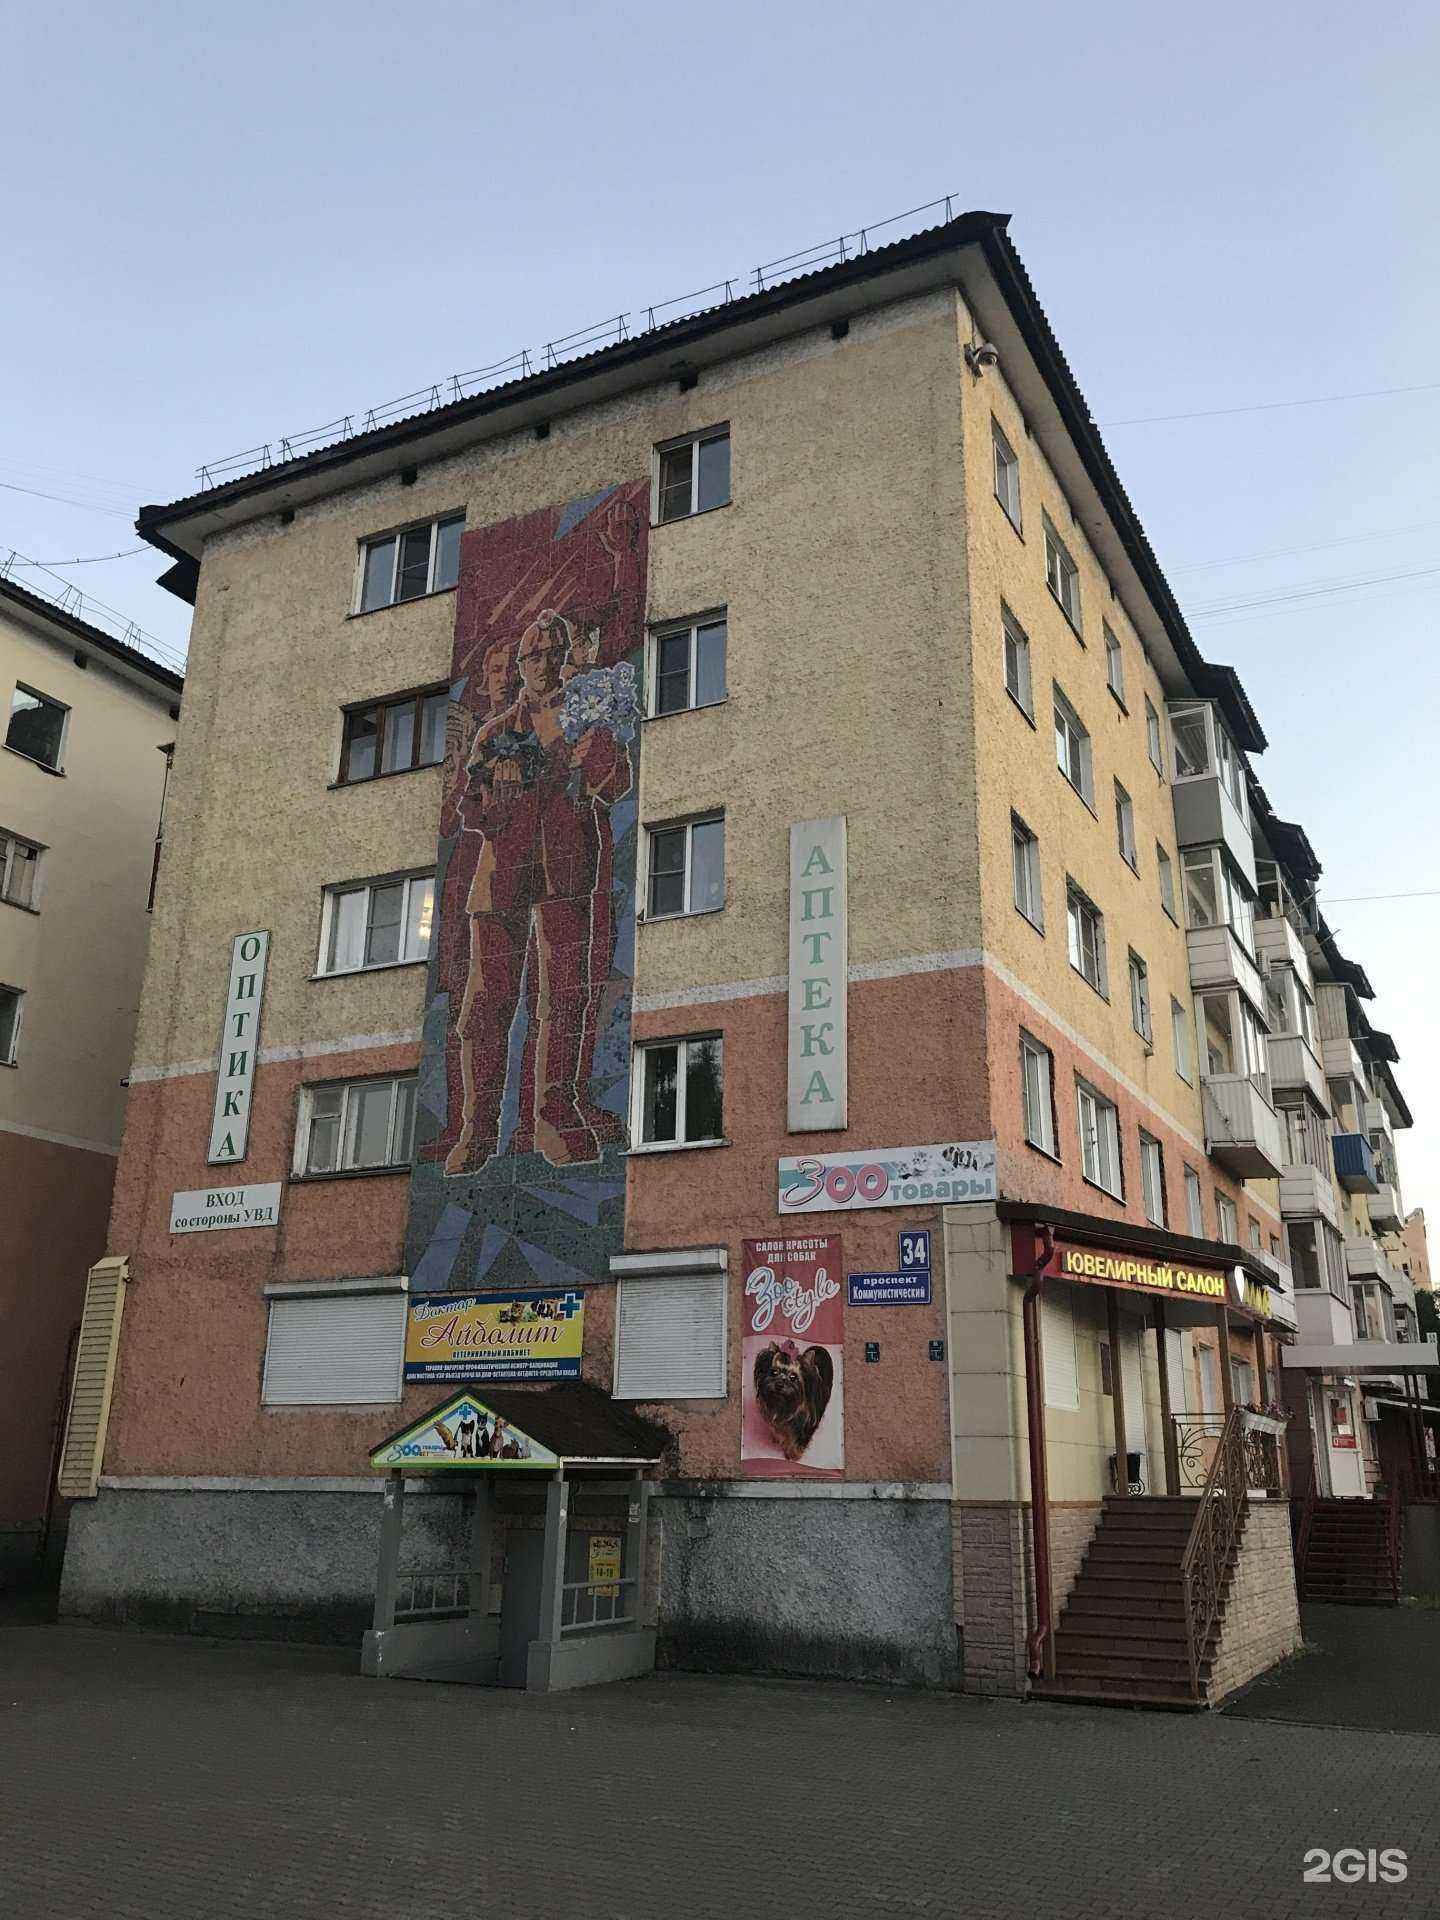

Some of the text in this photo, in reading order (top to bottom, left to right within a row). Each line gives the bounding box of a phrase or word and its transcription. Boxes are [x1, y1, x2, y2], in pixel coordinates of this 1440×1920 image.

[800, 845, 835, 1105] АПТЕКА
[216, 937, 261, 1157] ОПТИКА
[206, 1191, 245, 1208] ВХОД
[891, 1178, 993, 1201] товары
[243, 1207, 273, 1222] УВД
[756, 1239, 828, 1252] САЛОН КРАСОТЫ
[787, 1251, 817, 1262] СОБАК
[903, 1237, 926, 1265] 34
[863, 1276, 918, 1286] проспект
[1066, 1251, 1225, 1297] ЮВЕЛИРНЫЙ САЛОН
[853, 1286, 926, 1301] Коммунистический
[414, 1297, 477, 1322] Доктор
[420, 1315, 567, 1348] Айболит
